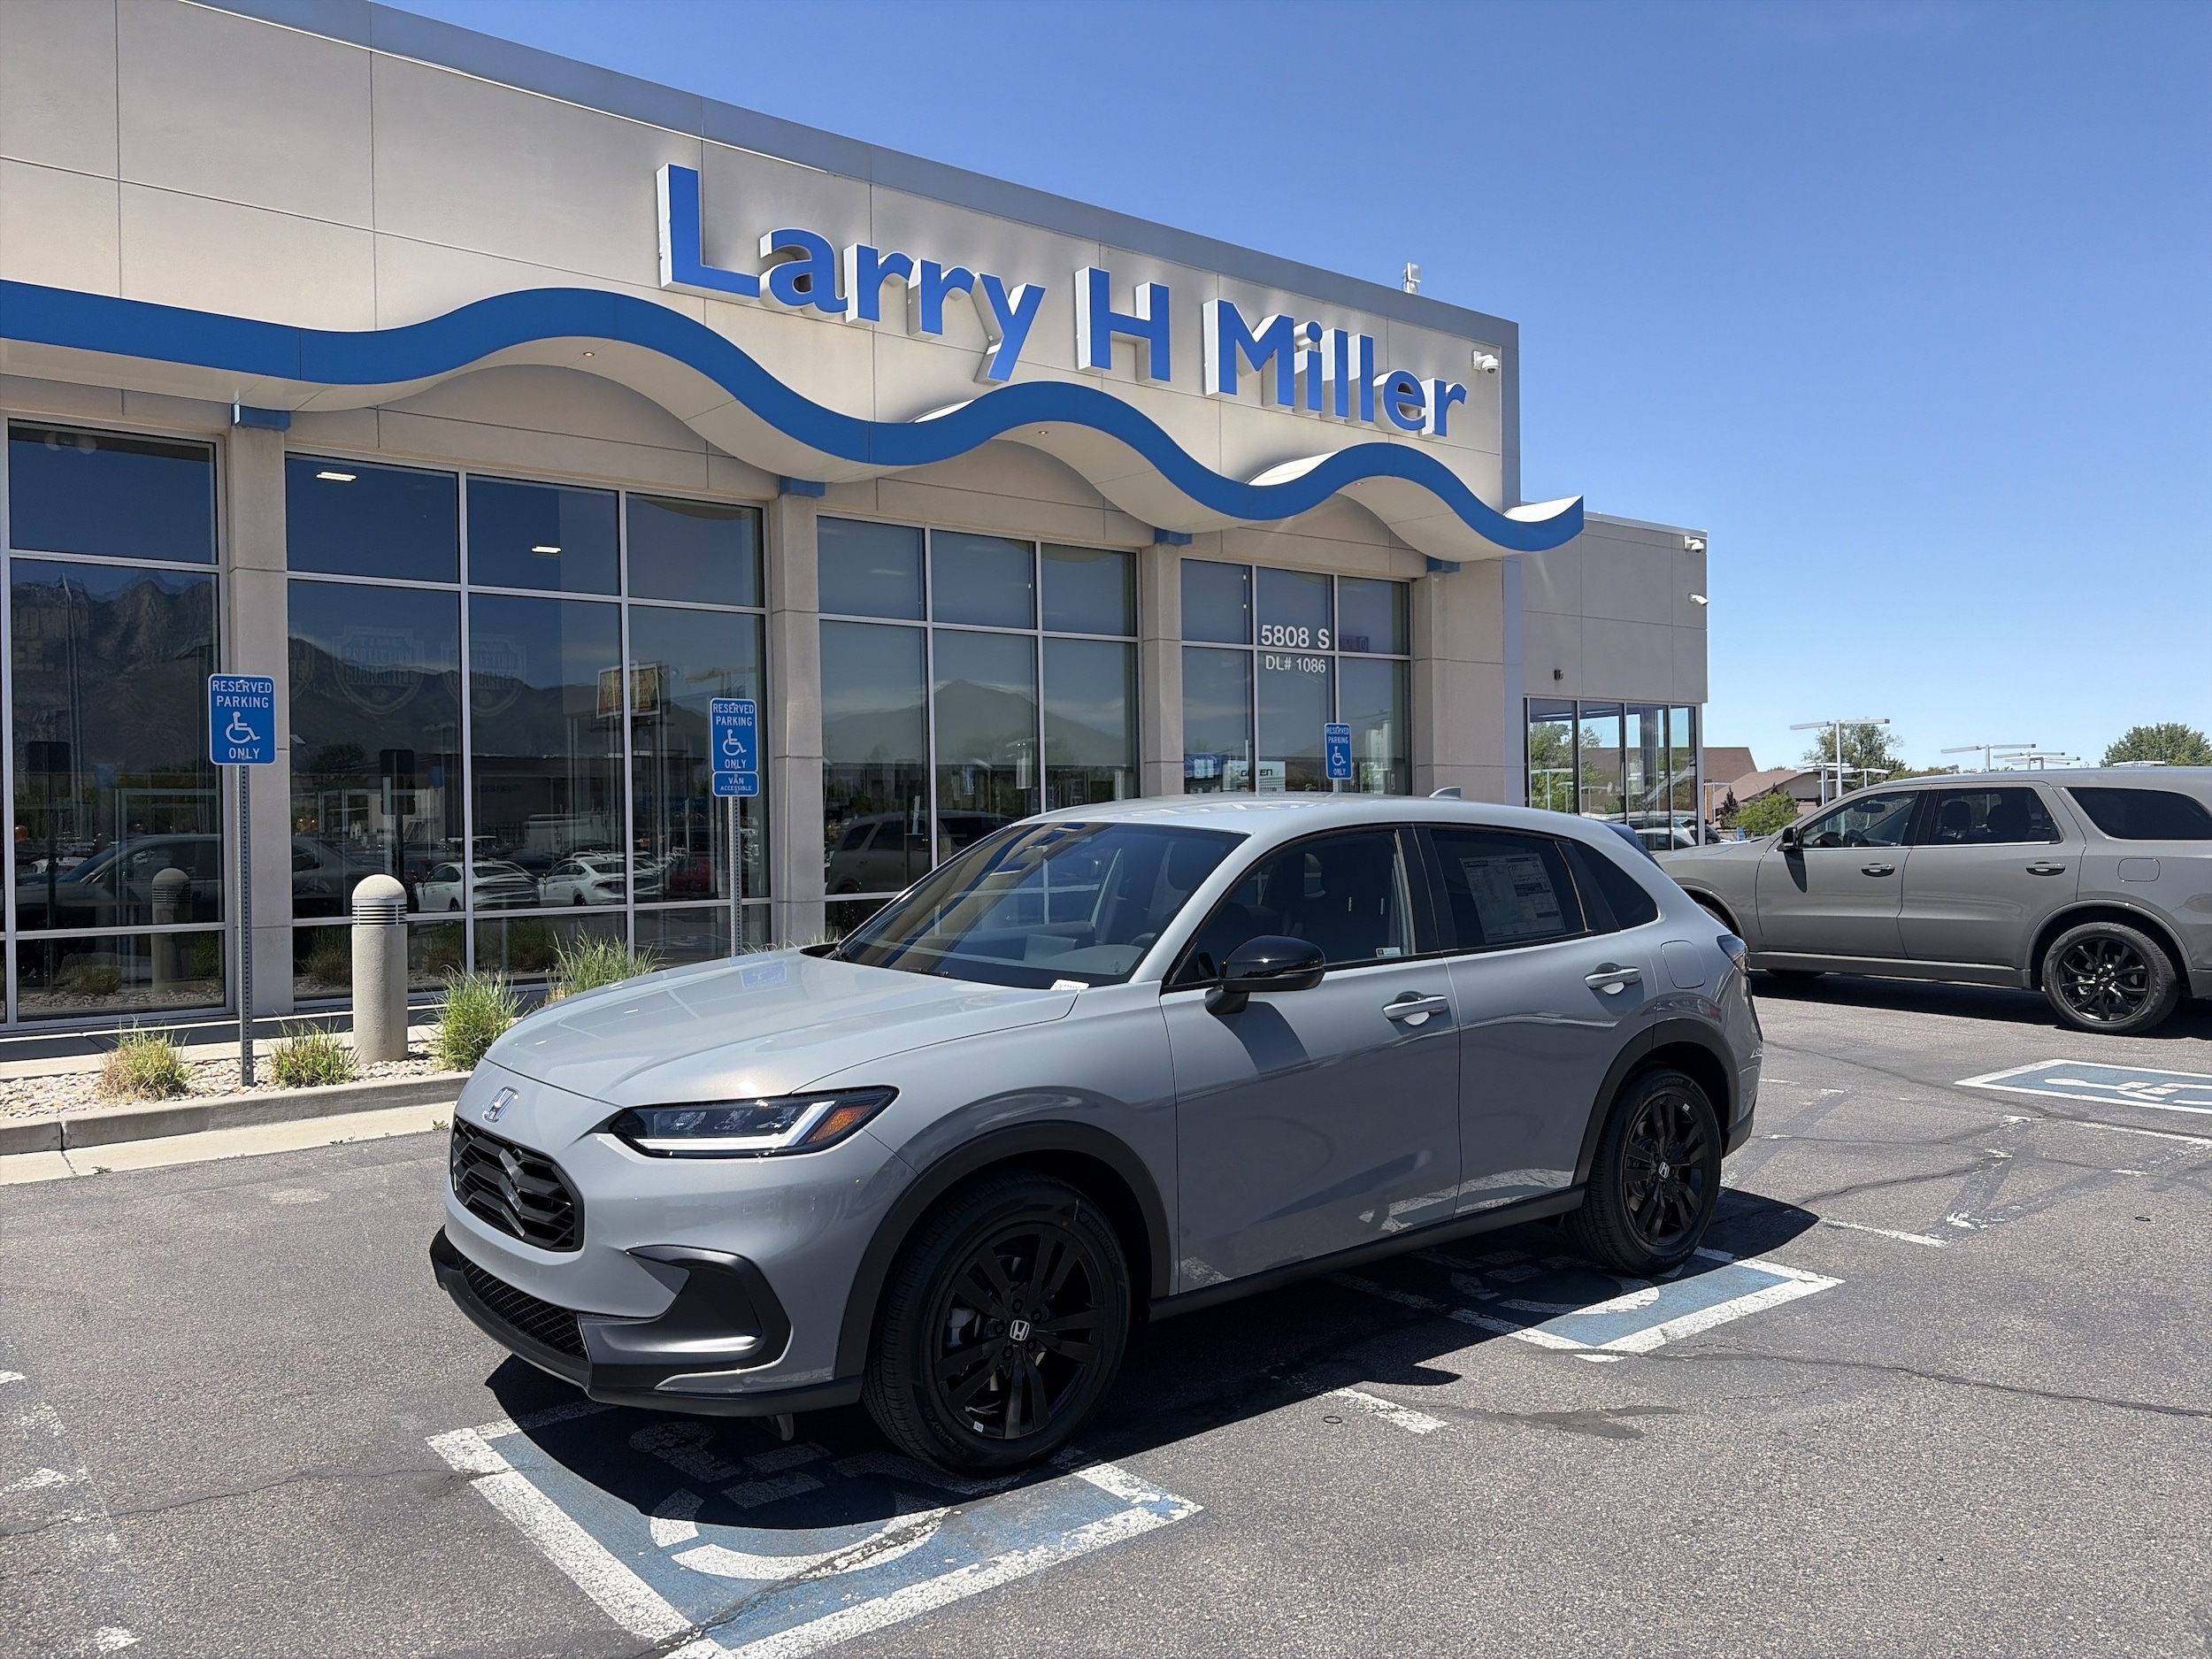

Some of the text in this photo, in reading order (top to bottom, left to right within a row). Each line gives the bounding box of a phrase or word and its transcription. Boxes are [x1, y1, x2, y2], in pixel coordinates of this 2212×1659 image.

[657, 164, 1467, 439] Larry H Miller
[1261, 625, 1310, 648] 5808
[1317, 628, 1330, 649] S
[1265, 655, 1326, 673] DL# 1086
[212, 680, 273, 694] RESERVED
[217, 695, 269, 708] PARKING
[713, 703, 754, 714] RESERVED
[716, 716, 752, 726] PARKING
[1326, 726, 1349, 735] RESERVED
[228, 747, 260, 759] ONLY
[725, 759, 747, 769] ONLY
[1333, 767, 1346, 776] ONLY
